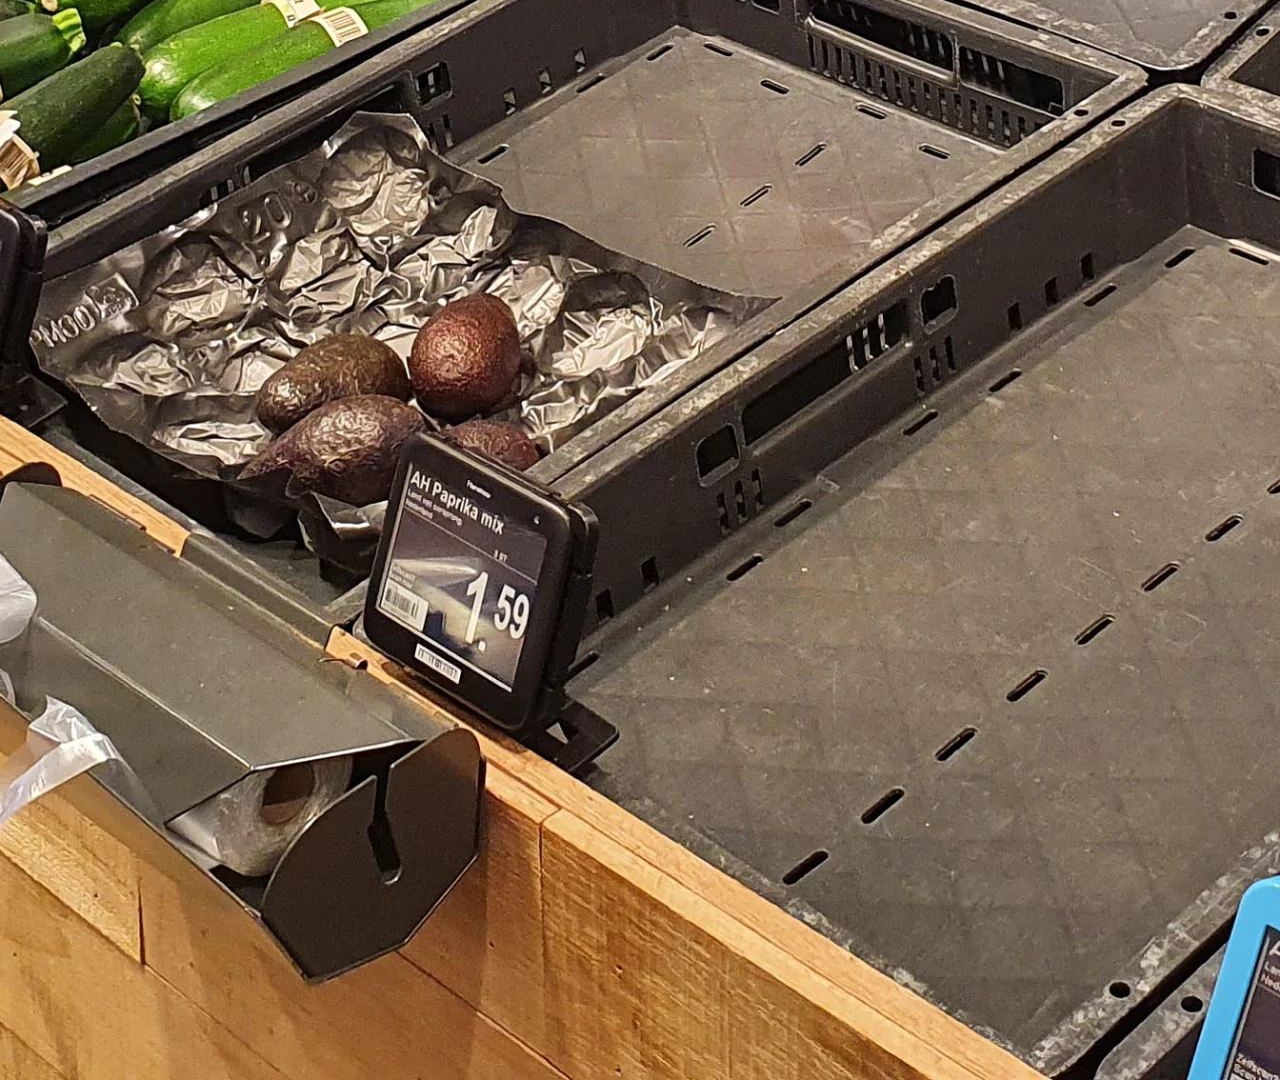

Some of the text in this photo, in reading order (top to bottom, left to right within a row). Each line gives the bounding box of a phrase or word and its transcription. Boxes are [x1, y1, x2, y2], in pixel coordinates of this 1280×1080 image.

[410, 470, 505, 535] AH Paprika mix
[465, 570, 531, 653] 1.59
